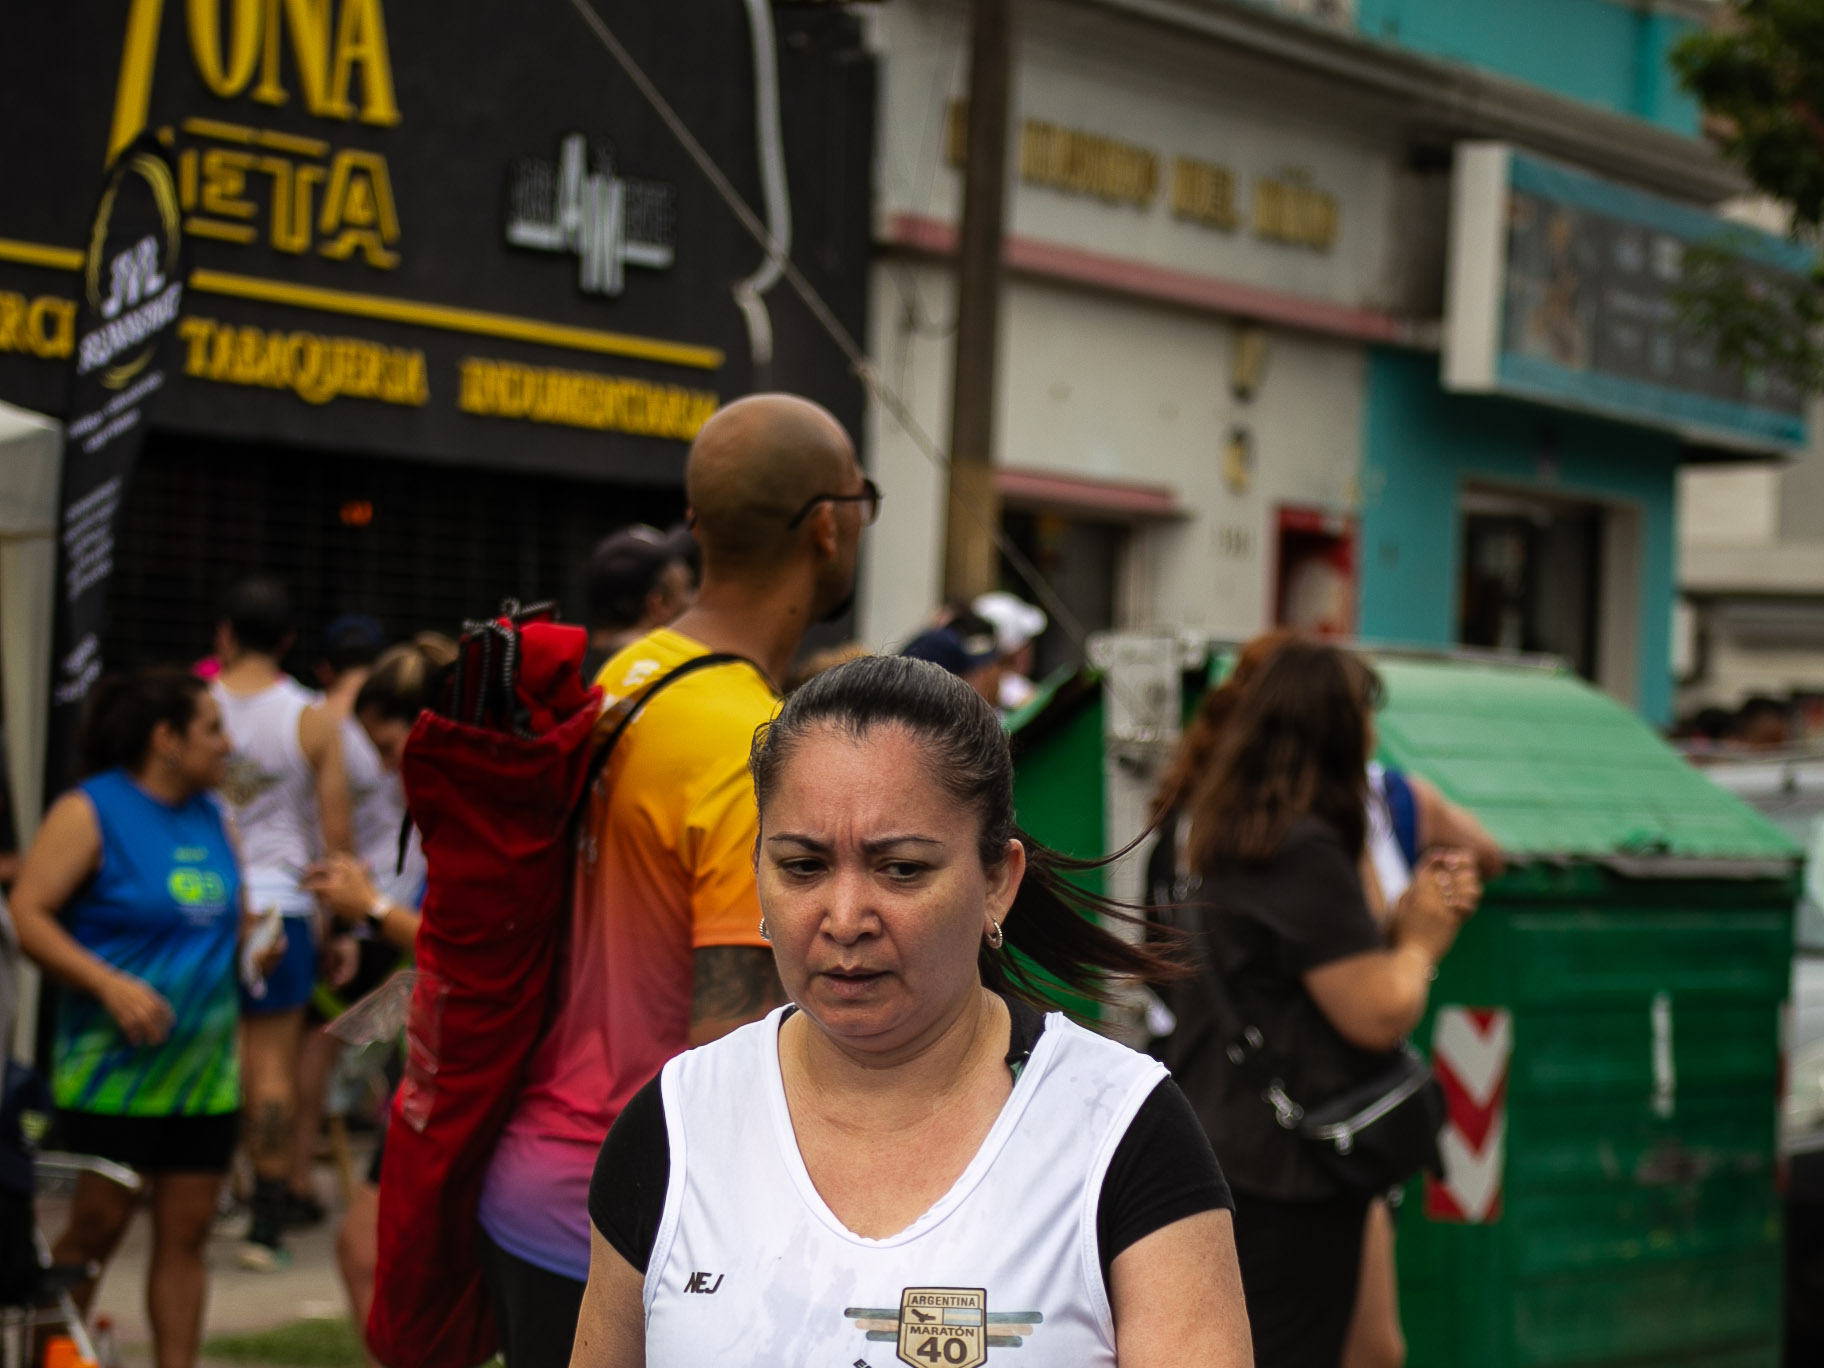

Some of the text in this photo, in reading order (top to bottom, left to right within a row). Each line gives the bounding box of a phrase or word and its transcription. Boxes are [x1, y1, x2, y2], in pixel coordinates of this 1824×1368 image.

[911, 1295, 976, 1307] ARGENTINA
[909, 1325, 975, 1337] MARATÓN
[916, 1336, 968, 1364] 40
